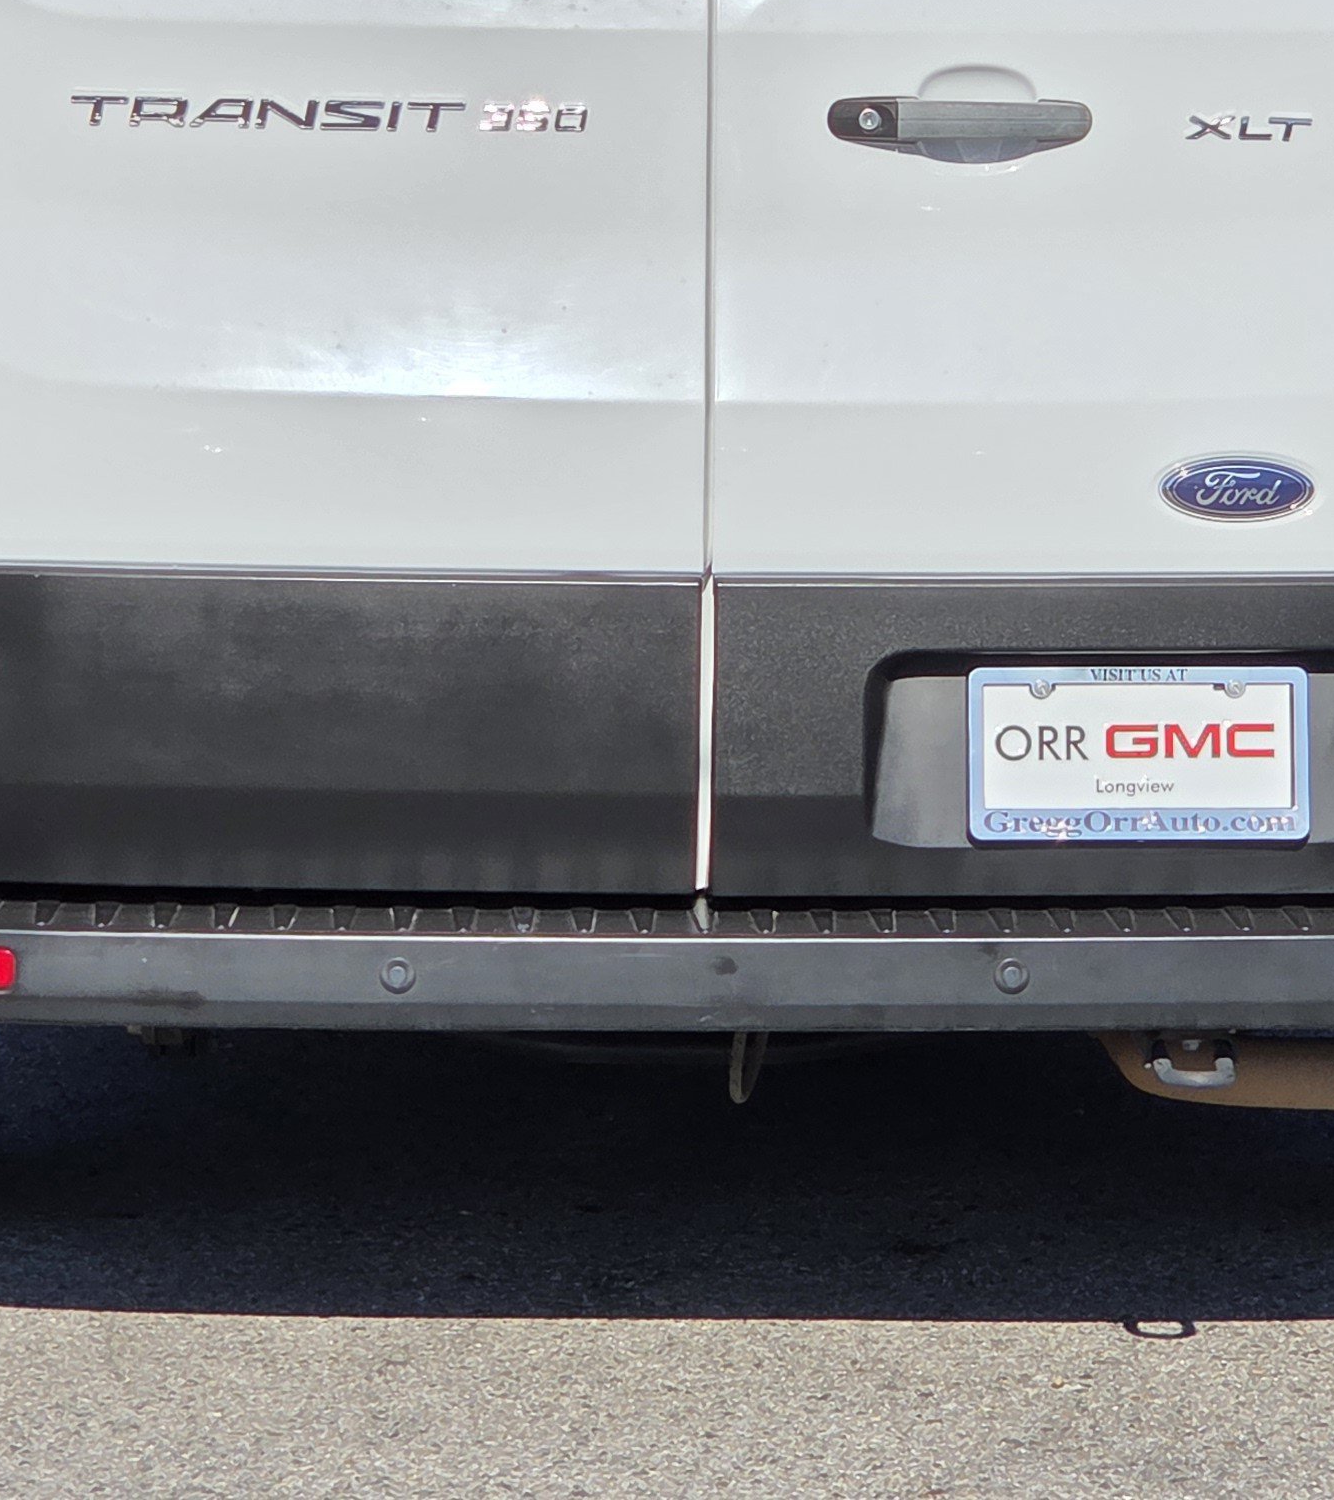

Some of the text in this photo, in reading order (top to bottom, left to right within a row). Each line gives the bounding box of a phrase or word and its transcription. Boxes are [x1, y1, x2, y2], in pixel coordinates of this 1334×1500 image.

[71, 94, 467, 133] TRANSIT
[1185, 115, 1313, 142] XLT
[1196, 470, 1282, 507] Ford
[1090, 668, 1188, 681] VISIT US AT
[995, 723, 1275, 761] ORR GMC
[1096, 778, 1175, 796] Longview
[983, 810, 1297, 838] GreggOrrAuto.com
